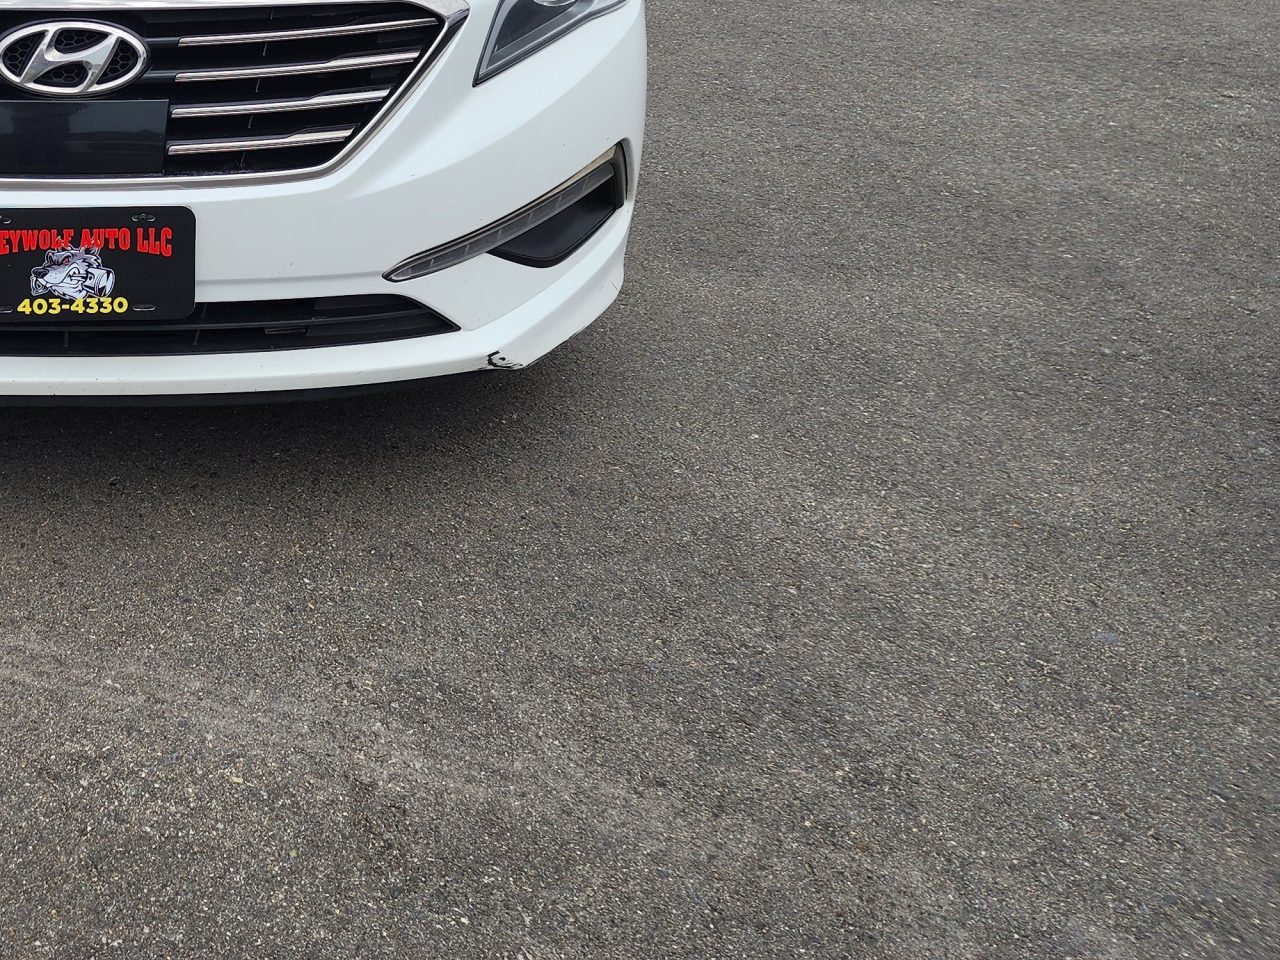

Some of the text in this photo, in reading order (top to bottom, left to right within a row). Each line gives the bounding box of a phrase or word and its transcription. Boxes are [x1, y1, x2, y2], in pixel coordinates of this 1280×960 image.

[81, 227, 131, 252] AUTO
[136, 226, 173, 257] LLC
[16, 296, 129, 315] 403-4330
